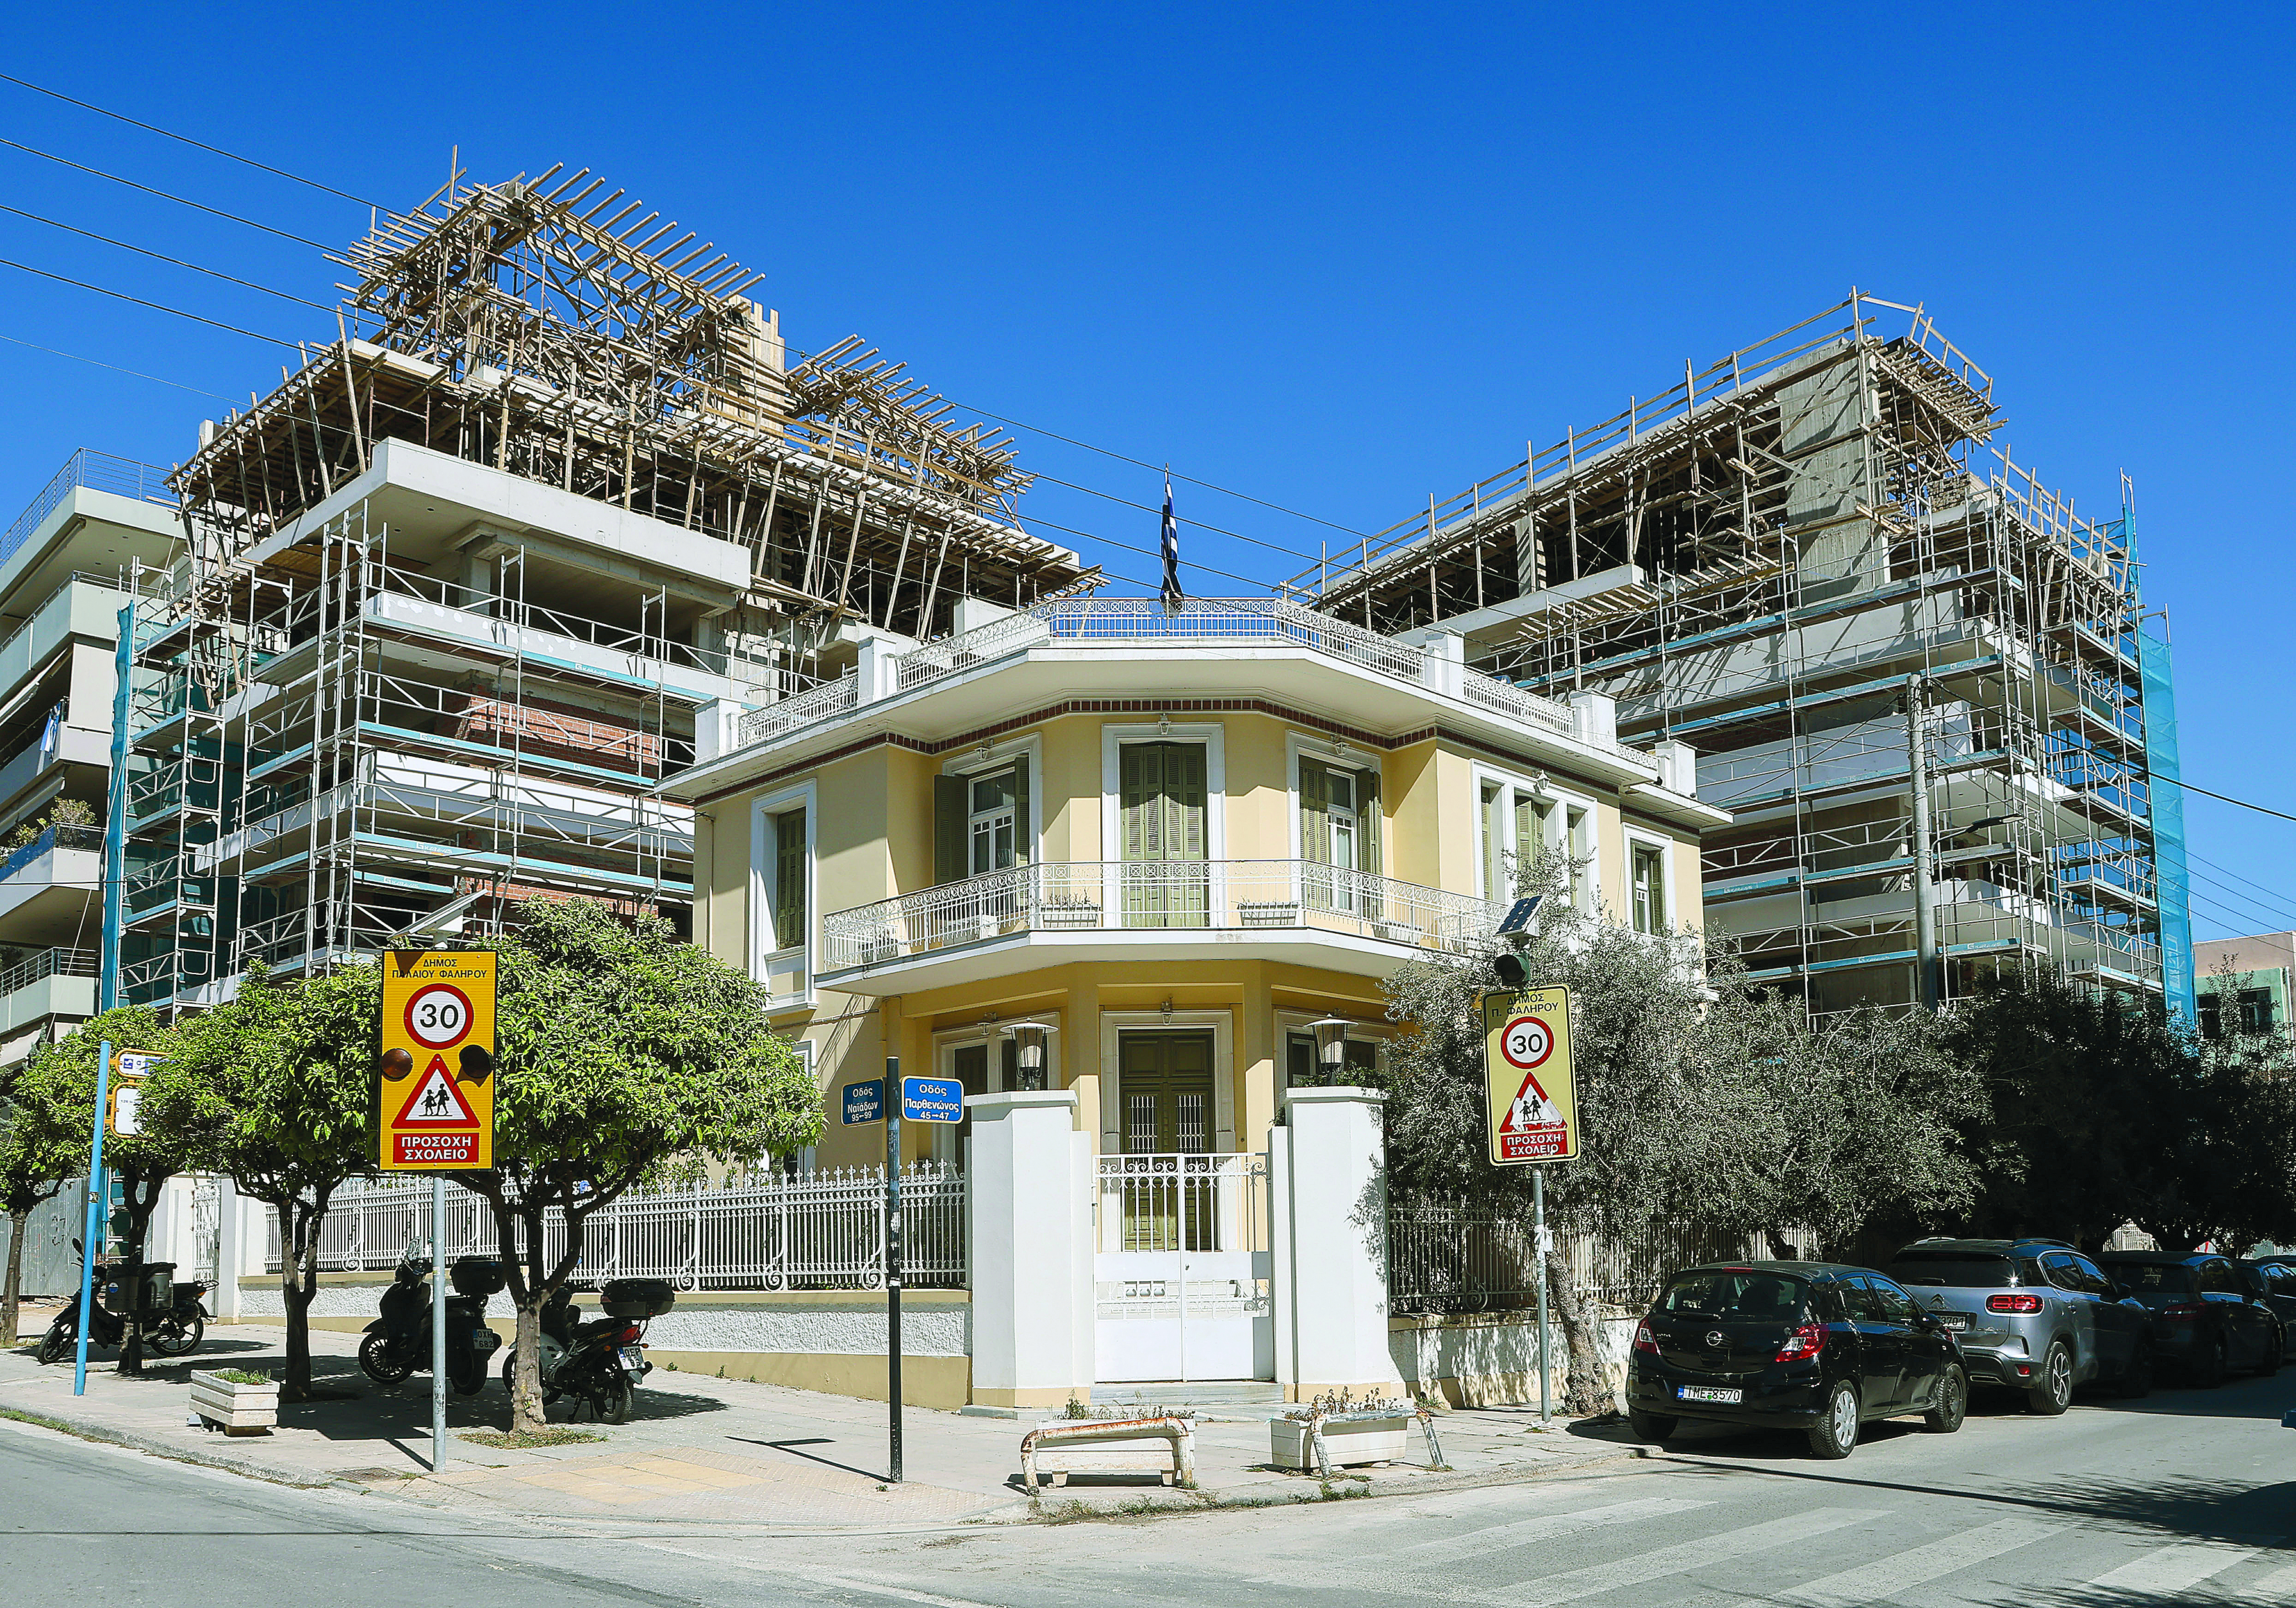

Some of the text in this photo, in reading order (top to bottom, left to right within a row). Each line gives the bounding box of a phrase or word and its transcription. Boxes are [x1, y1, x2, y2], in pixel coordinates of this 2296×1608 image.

[423, 959, 458, 968] ΔΗΜΟΣ
[392, 970, 487, 979] ΠΑΛΑΙΟΥ ΦΑΛΗΡΟΥ
[1507, 993, 1545, 1006] ΔΗΜΟΣ
[1507, 1002, 1559, 1015] ΦΑΛΗΡΟΥ
[420, 1004, 459, 1029] 30
[1512, 1033, 1543, 1054] 30
[852, 1086, 873, 1097] Οδός
[919, 1084, 947, 1097] Οδός
[847, 1100, 879, 1114] Ναϊάδων
[905, 1098, 959, 1113] Παρθενώνος
[401, 1136, 471, 1148] ΠΡΟΣΟΧΗ
[1507, 1133, 1561, 1146] ΠΡΟΣΟΧΗ
[404, 1148, 468, 1161] ΣΧΟΛΕΙΟ
[1510, 1143, 1559, 1156] ΣΧΟΛΕΙΟ
